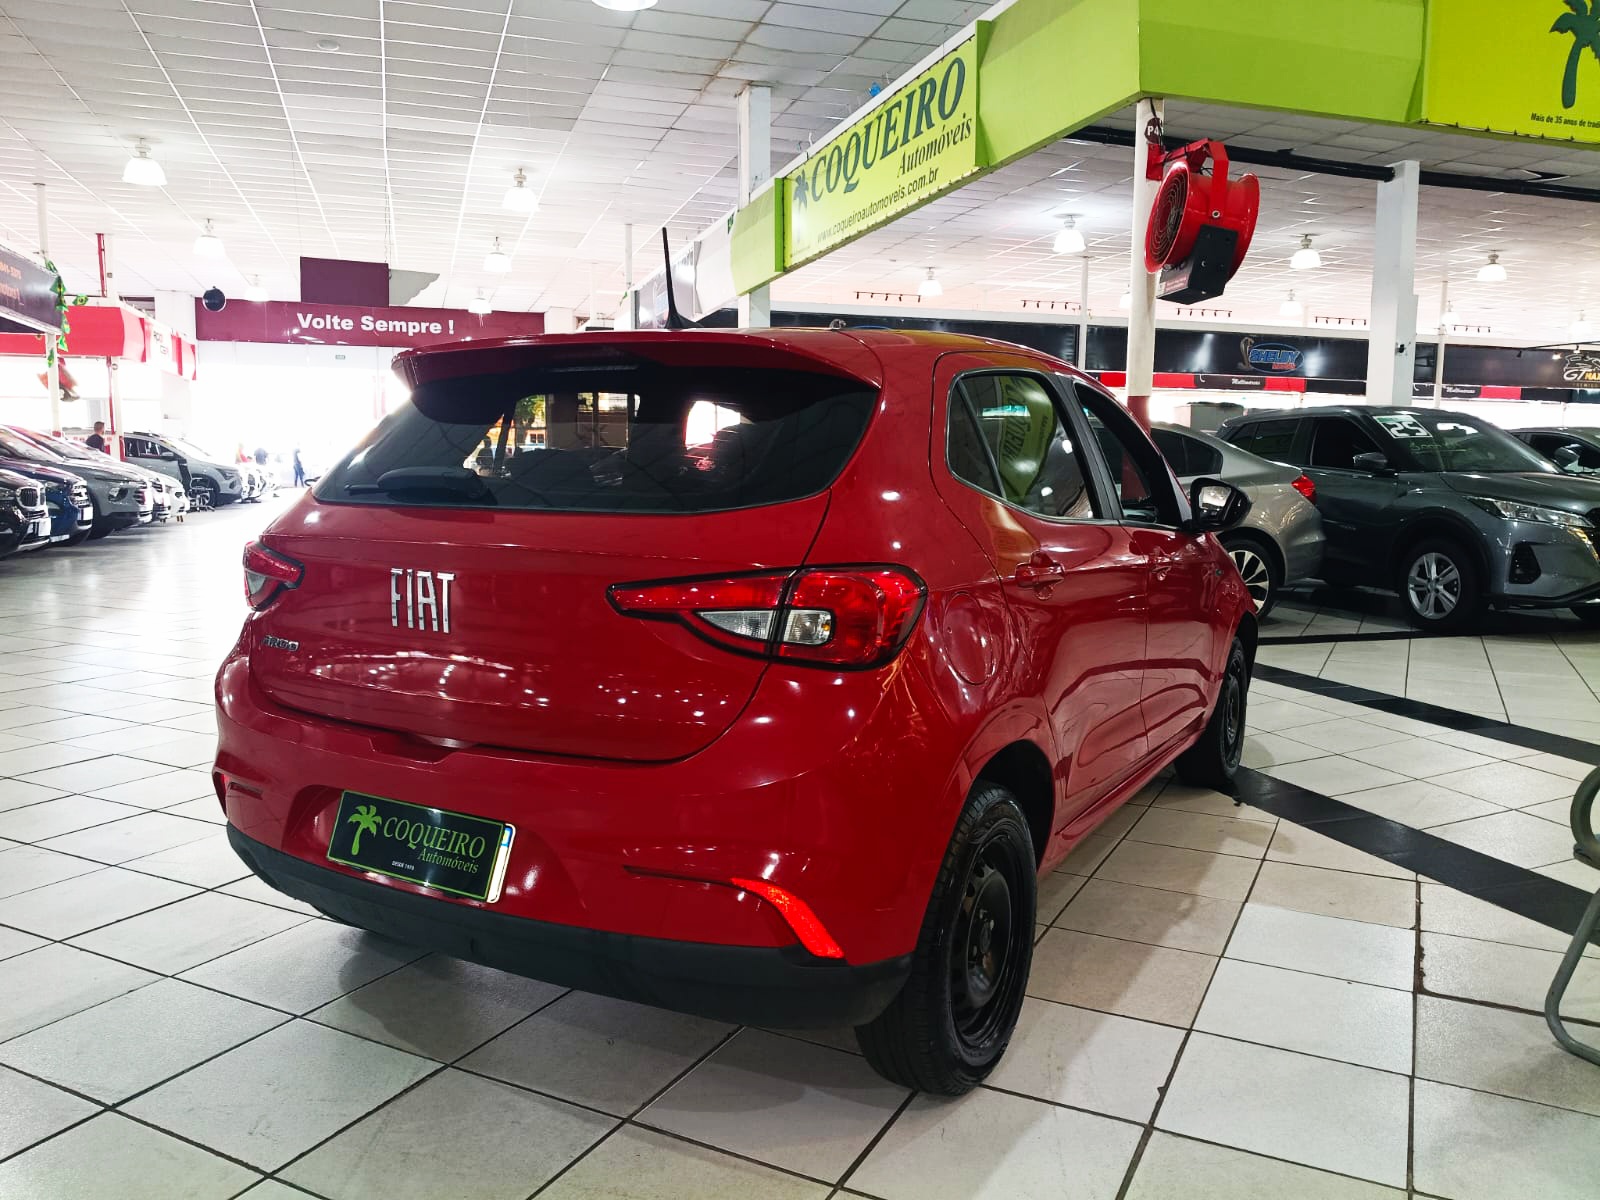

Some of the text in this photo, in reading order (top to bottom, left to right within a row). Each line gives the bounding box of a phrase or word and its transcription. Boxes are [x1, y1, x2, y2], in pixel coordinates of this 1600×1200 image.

[811, 57, 966, 203] COQUEIRO
[1530, 112, 1545, 122] Mais
[1546, 115, 1554, 123] de
[1578, 119, 1586, 127] de
[897, 112, 973, 179] Automóveis
[817, 166, 939, 244] www.coqueiroautomoveis.com.br
[296, 312, 455, 337] Volte Sempre !
[1387, 421, 1428, 437] 25
[390, 567, 455, 634] FIAT
[383, 816, 486, 859] COQUEIRO
[417, 847, 480, 874] Automóveis
